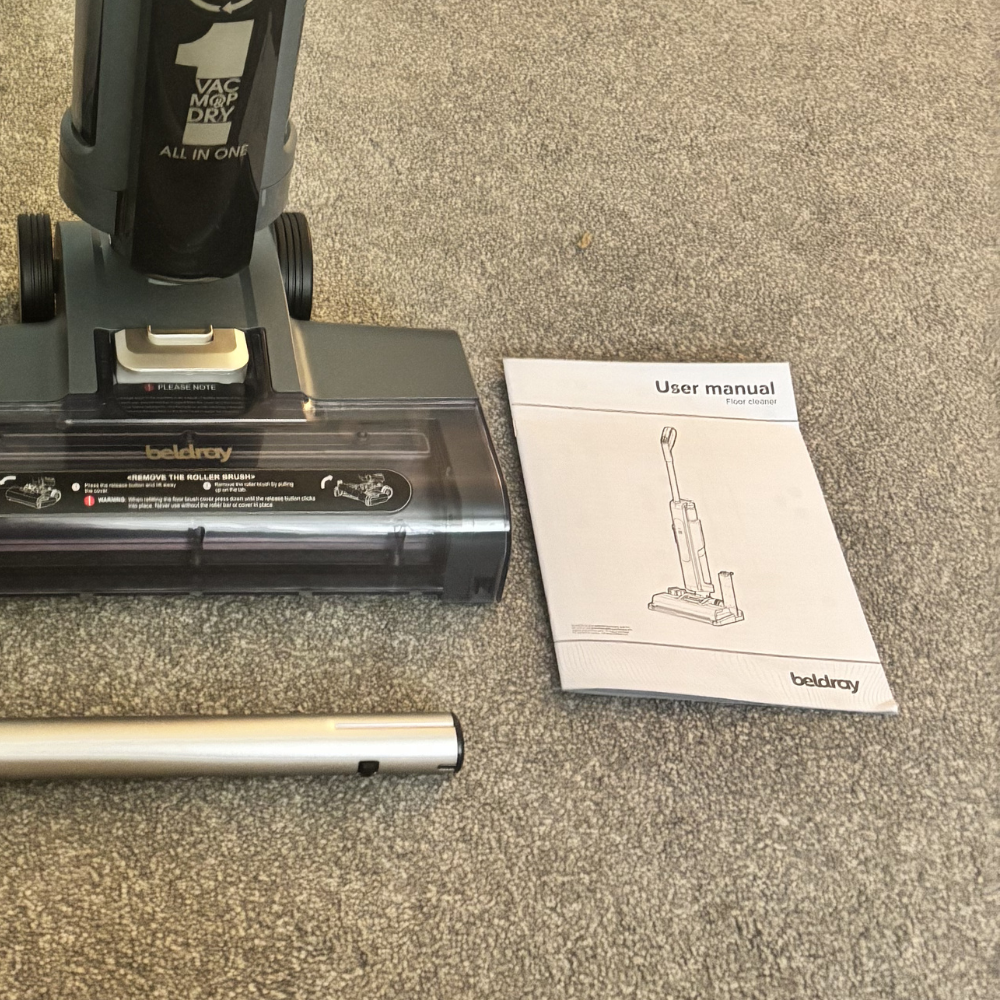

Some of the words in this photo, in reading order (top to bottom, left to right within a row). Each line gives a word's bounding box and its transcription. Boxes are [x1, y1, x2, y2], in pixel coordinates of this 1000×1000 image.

[195, 77, 241, 94] VAC
[187, 107, 235, 123] DRY
[159, 145, 187, 160] ALL
[192, 147, 209, 161] IN
[214, 144, 249, 160] ONE
[158, 383, 192, 391] PLEASE
[192, 383, 217, 391] NOTE
[656, 380, 699, 395] User
[705, 381, 776, 395] manual
[726, 398, 746, 406] Floor
[748, 398, 777, 406] cleaner
[145, 443, 233, 463] beldray
[790, 671, 860, 694] beldray
